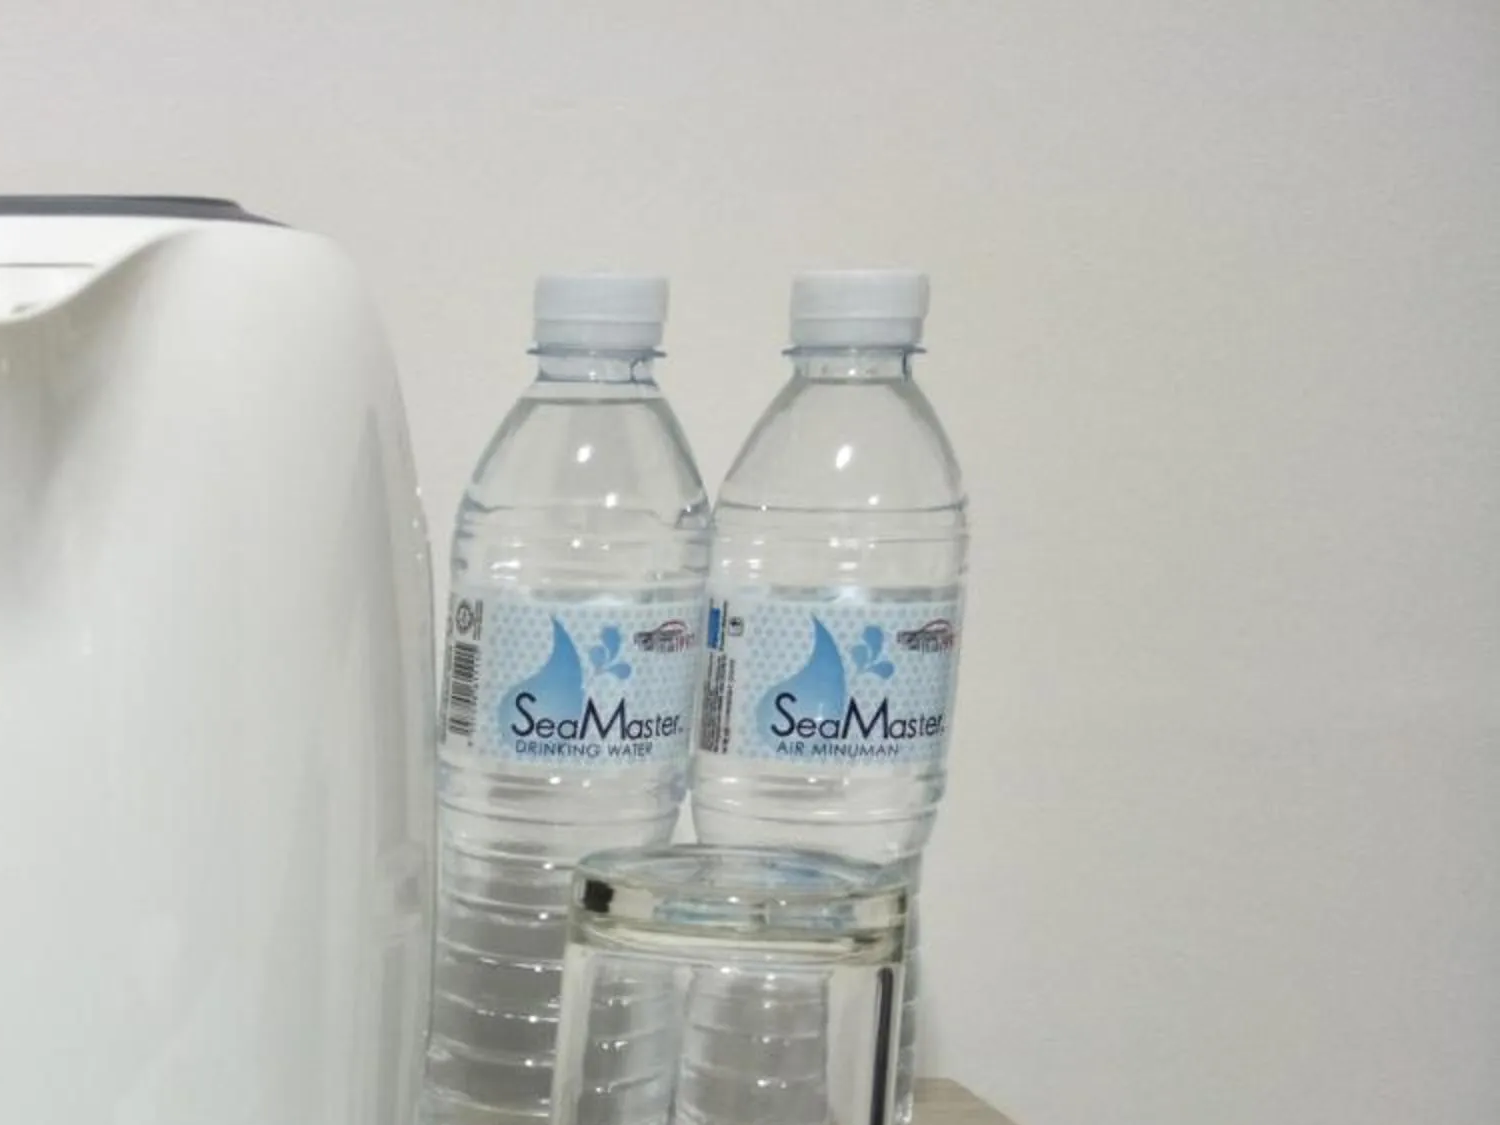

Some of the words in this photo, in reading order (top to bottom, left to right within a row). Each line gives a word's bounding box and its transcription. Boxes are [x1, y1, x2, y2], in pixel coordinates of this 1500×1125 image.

[511, 692, 681, 740] SeaMaster
[771, 692, 943, 739] SeaMaster
[515, 740, 600, 757] DRINKING
[608, 742, 653, 757] WATER
[776, 741, 804, 756] AIR
[812, 743, 899, 757] MINUMAN
